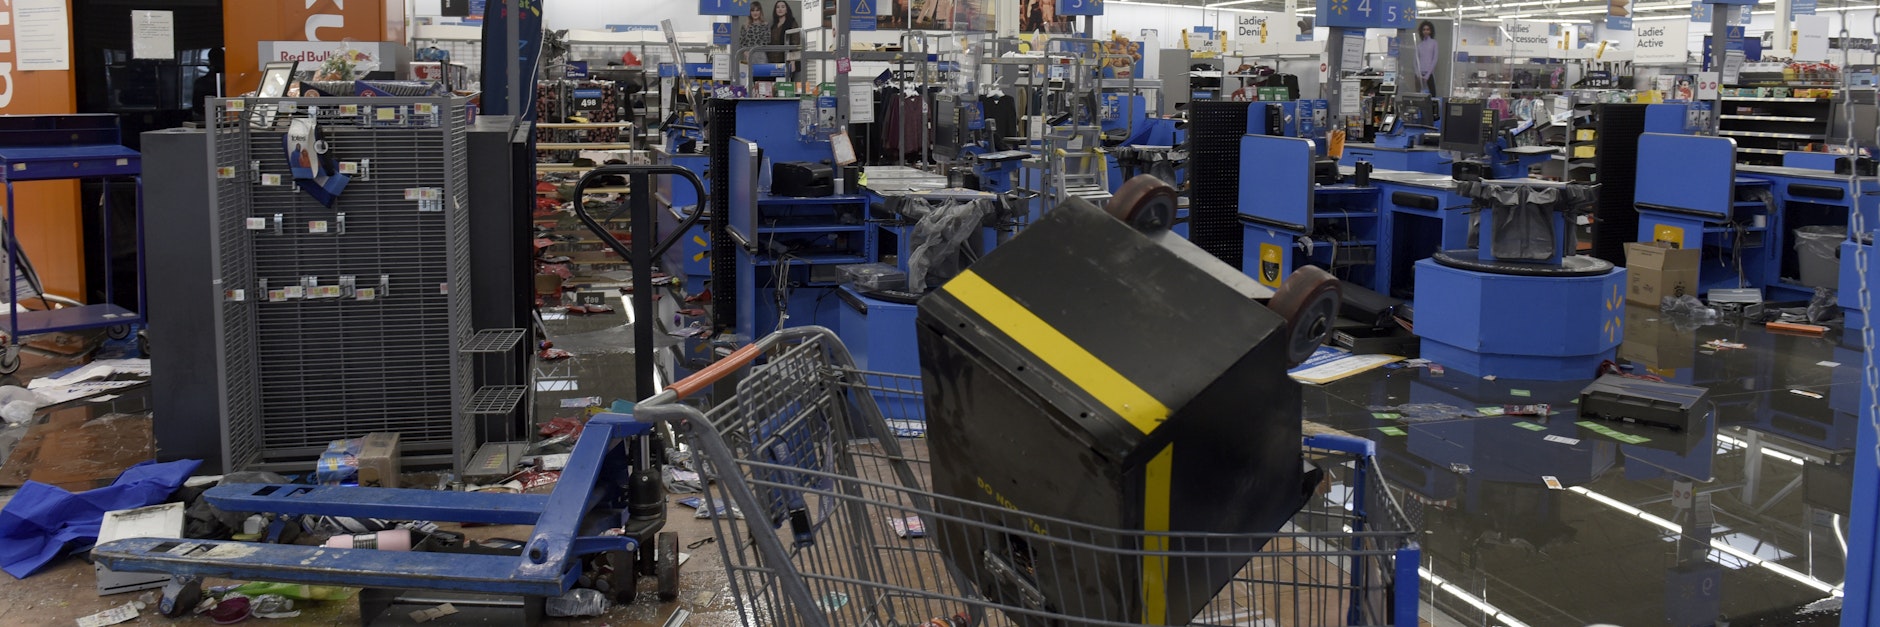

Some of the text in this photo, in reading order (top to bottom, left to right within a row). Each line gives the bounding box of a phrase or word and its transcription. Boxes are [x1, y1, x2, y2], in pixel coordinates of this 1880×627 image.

[1357, 0, 1372, 17] 4
[1387, 6, 1397, 22] 5
[1638, 26, 1666, 36] Ladies'
[1637, 38, 1664, 48] Active
[280, 51, 305, 62] Red
[977, 476, 993, 496] DO
